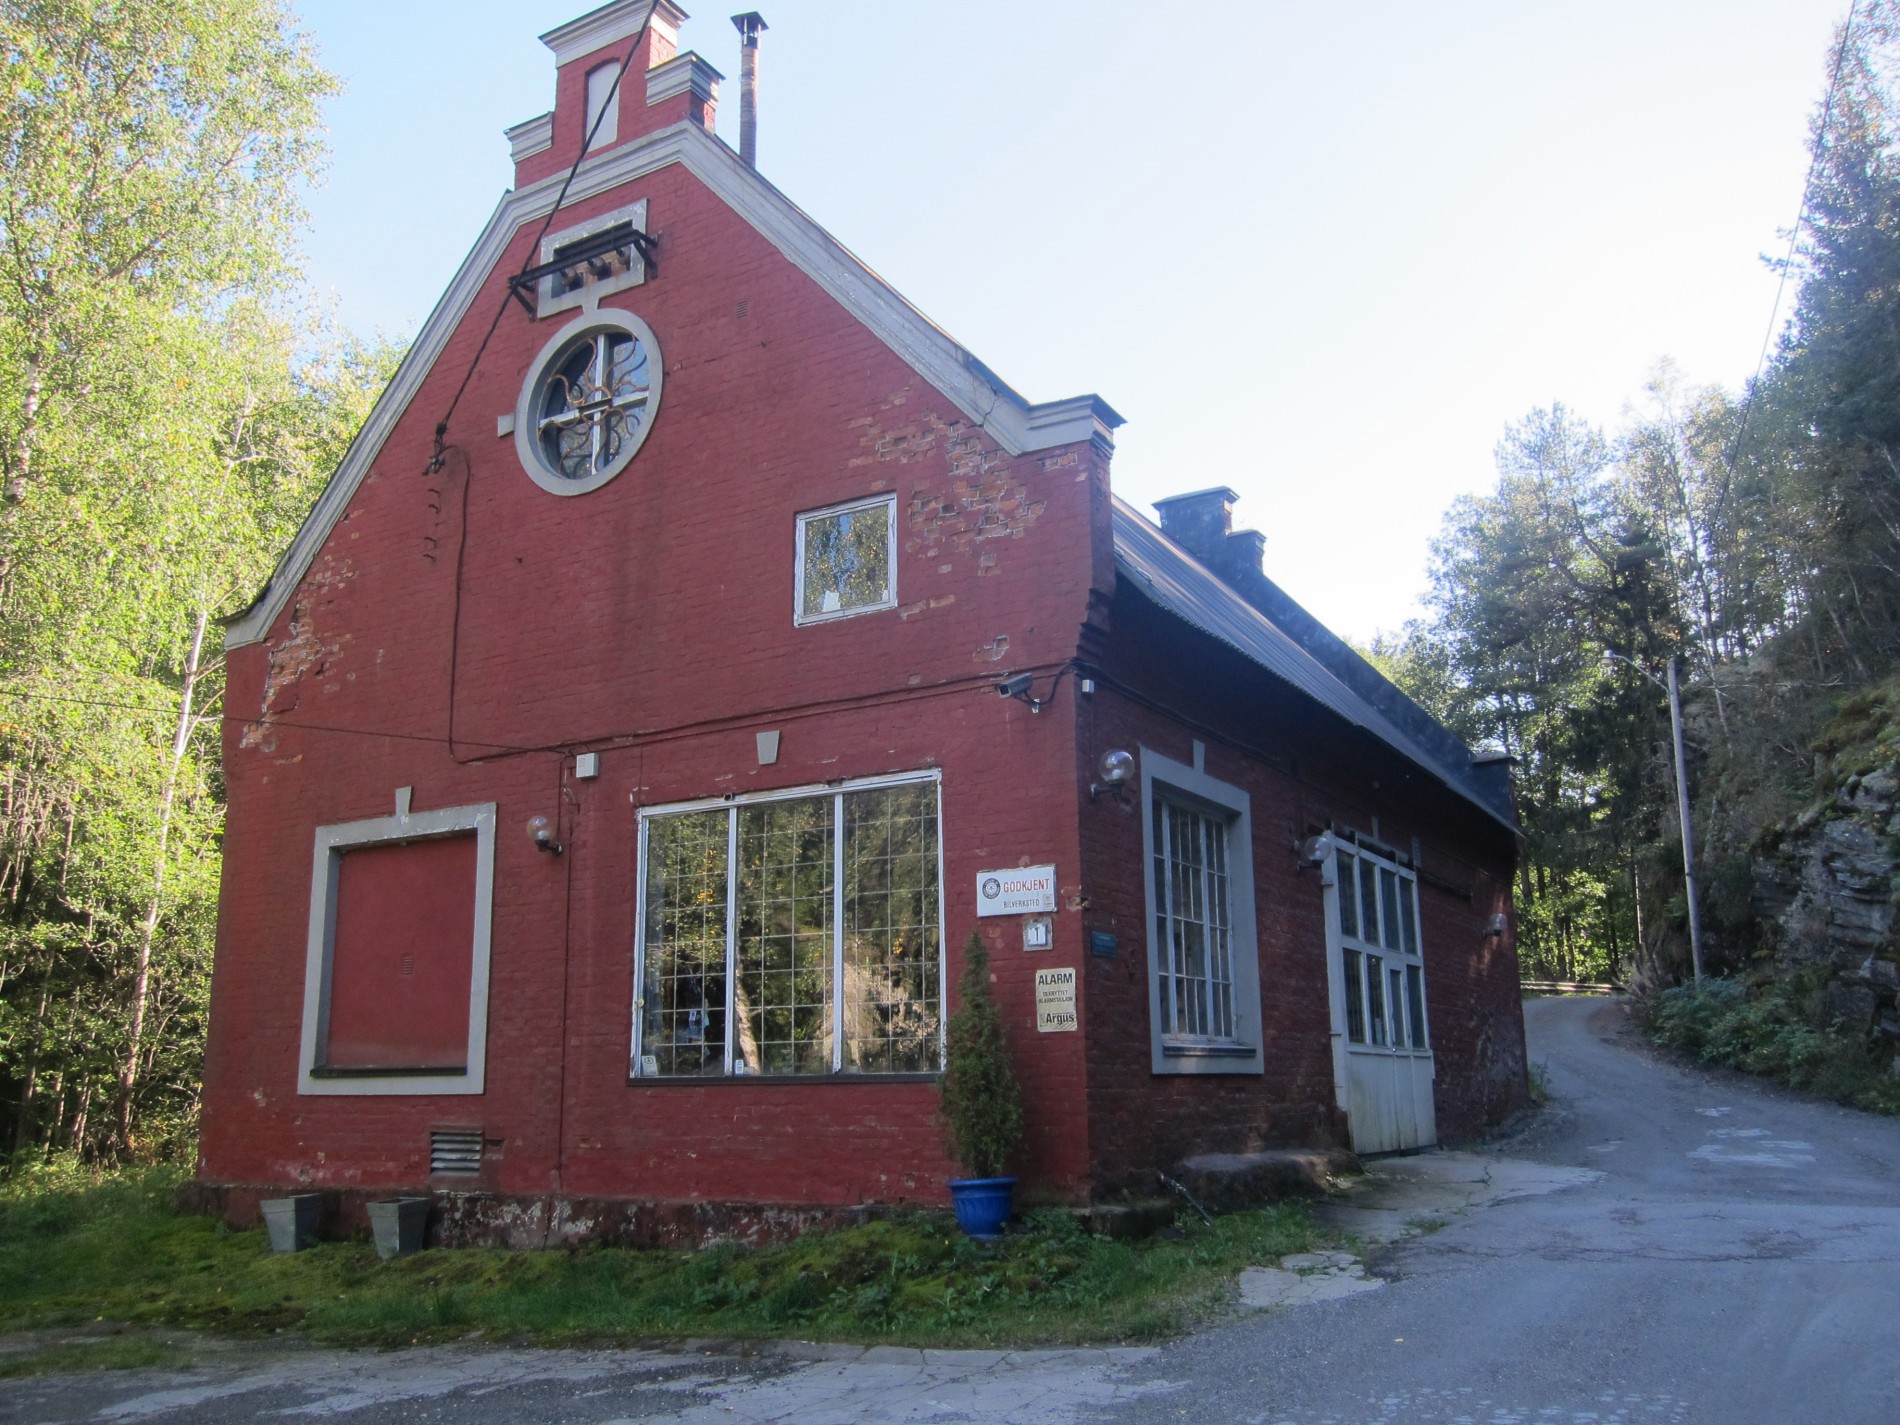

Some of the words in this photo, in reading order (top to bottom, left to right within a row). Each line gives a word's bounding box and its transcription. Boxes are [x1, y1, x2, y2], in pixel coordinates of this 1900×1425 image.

[1004, 879, 1050, 893] GODKJENT
[1004, 899, 1040, 909] BILVERKSTED
[1034, 927, 1039, 941] 1
[1038, 973, 1073, 986] ALARM
[1046, 1013, 1075, 1026] Argus
